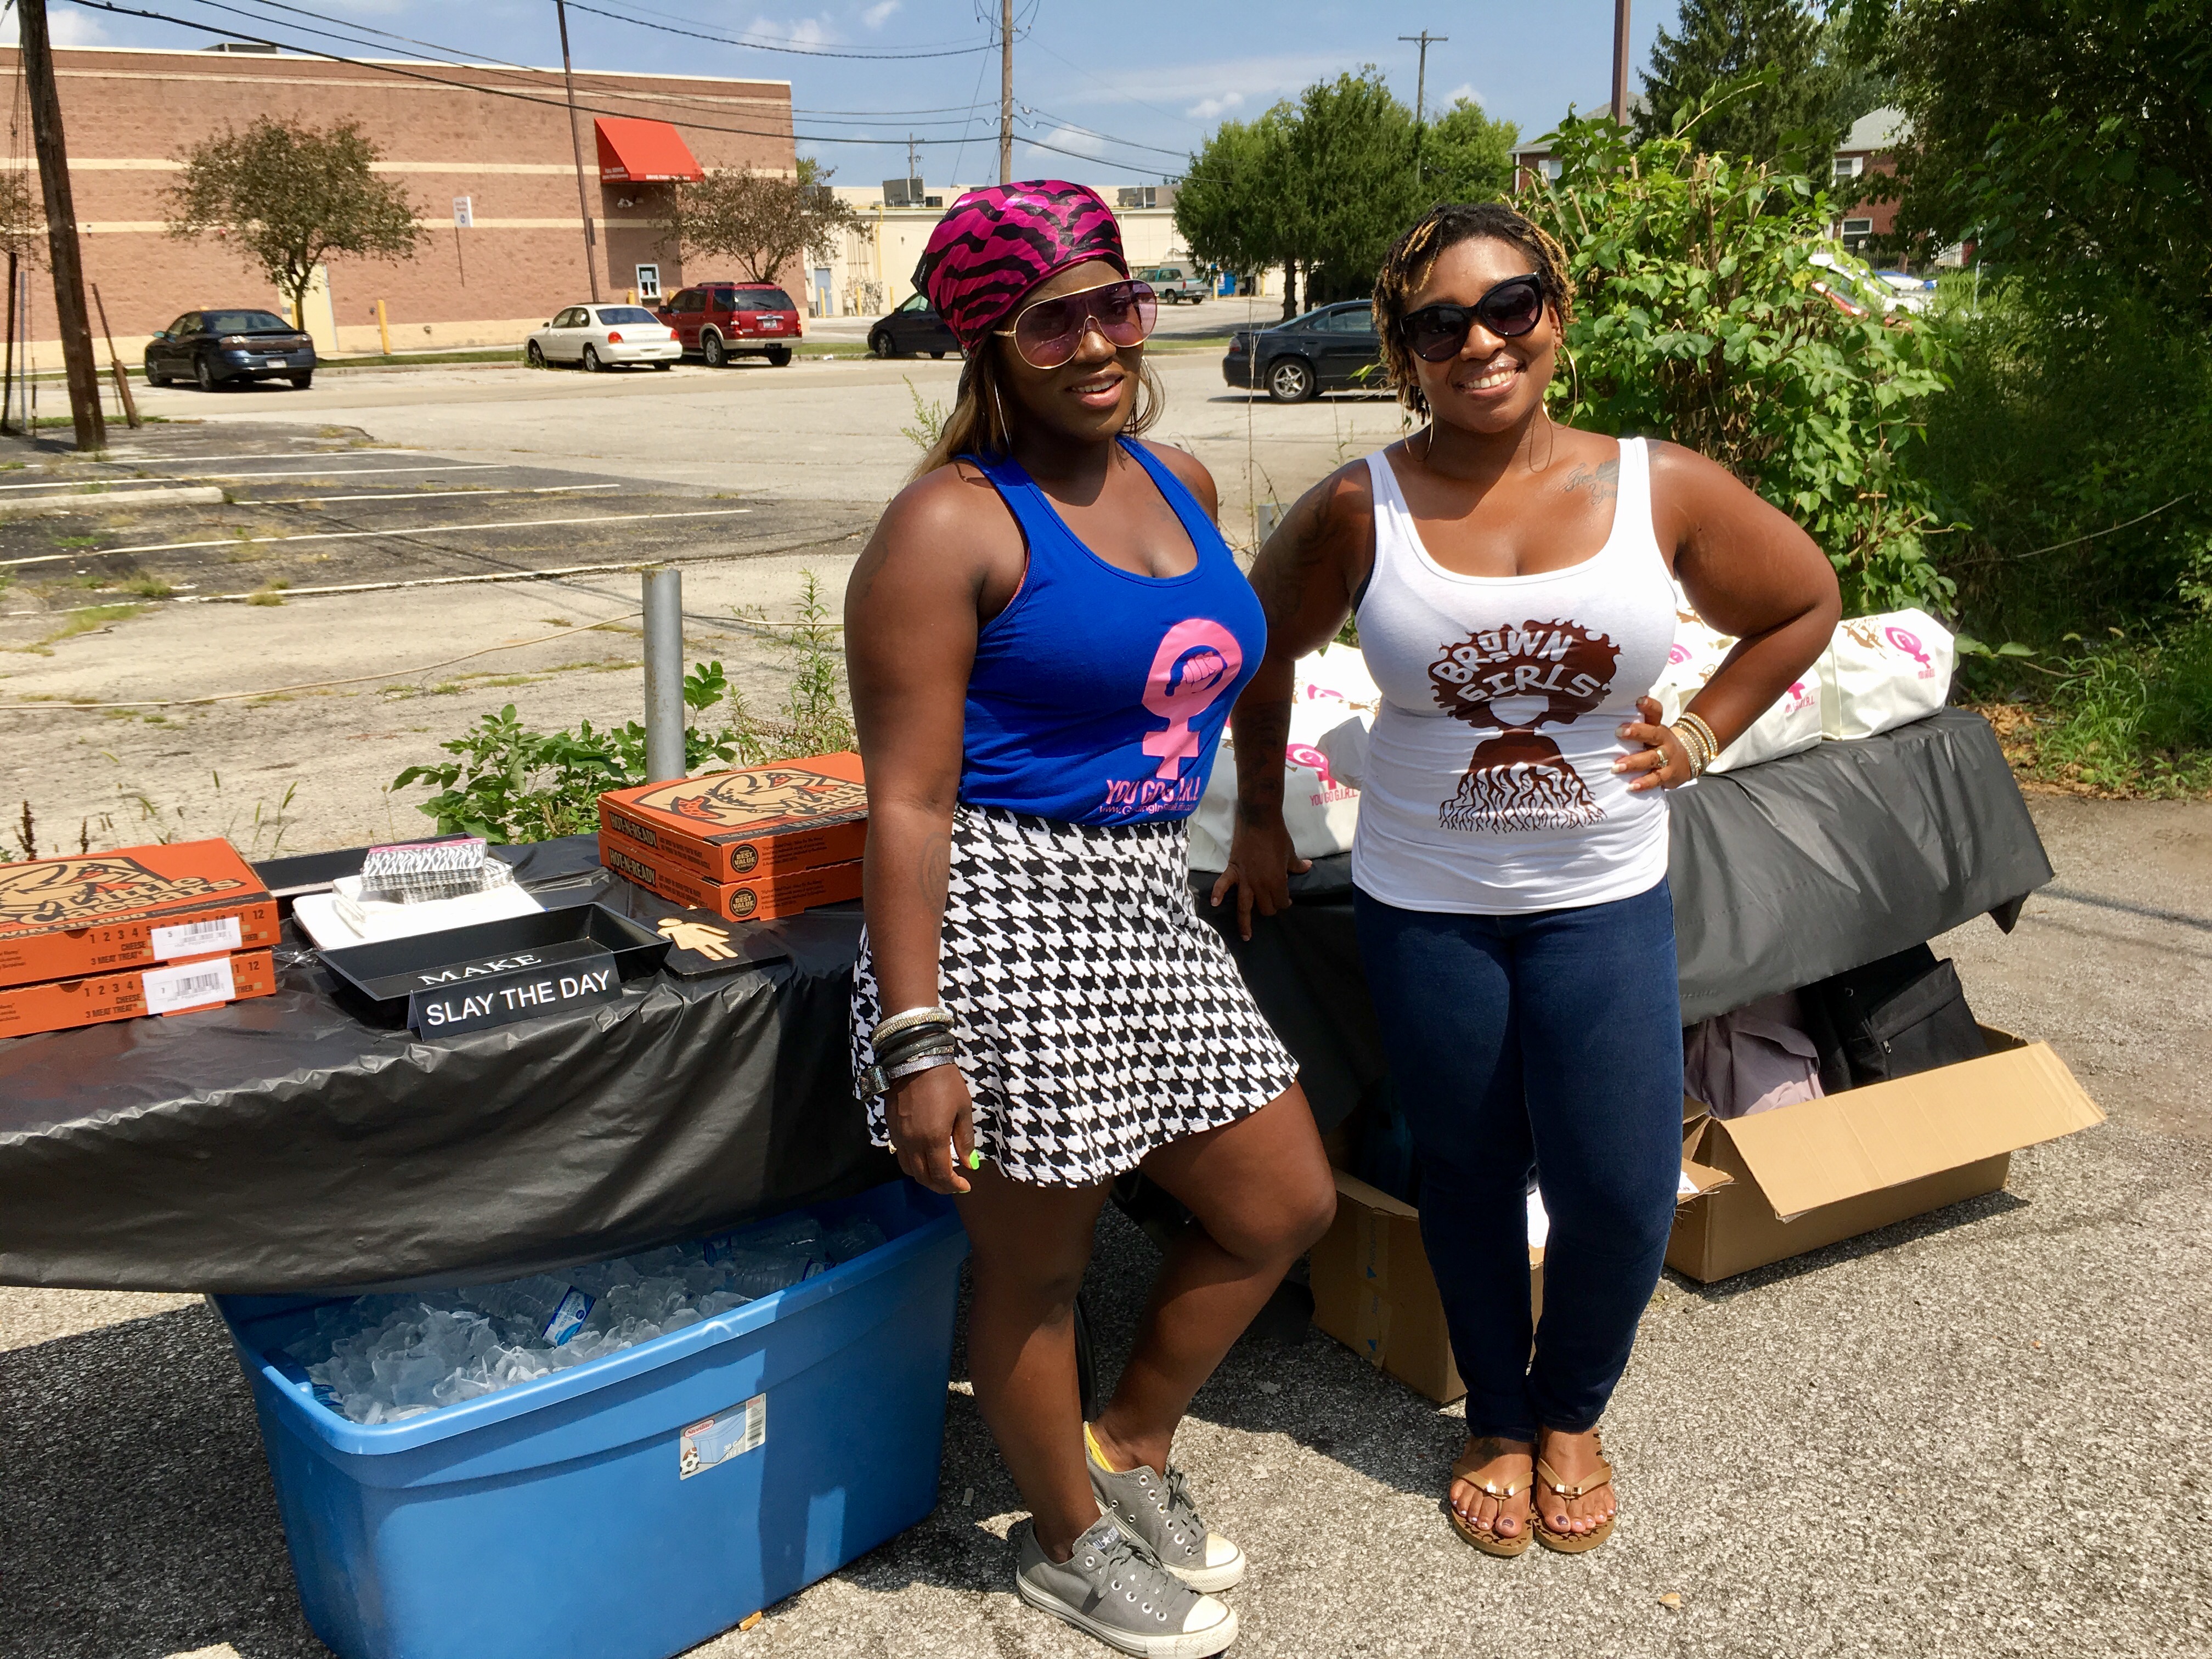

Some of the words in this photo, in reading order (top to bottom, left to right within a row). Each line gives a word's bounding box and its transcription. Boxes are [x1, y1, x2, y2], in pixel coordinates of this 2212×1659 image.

[1432, 630, 1573, 684] BROWN
[1457, 664, 1600, 702] GIRLS
[1105, 780, 1140, 805] YOU
[1141, 780, 1165, 804] GO
[1309, 793, 1323, 806] YOU
[1324, 791, 1334, 803] GO
[610, 812, 657, 848] HOT-N-READY
[787, 817, 828, 828] WIN
[609, 848, 656, 885] HOT-N-READY
[735, 857, 755, 865] VALUE
[20, 879, 241, 924] Caesars
[44, 878, 204, 912] Little
[733, 900, 754, 909] VALUE
[89, 934, 95, 944] 1
[104, 932, 110, 941] 2
[117, 930, 124, 939] 3
[132, 928, 138, 937] 4
[253, 909, 264, 919] 12
[121, 941, 146, 951] CHEESE
[98, 955, 116, 964] MEAT
[84, 988, 90, 997] 1
[98, 985, 105, 995] 2
[112, 983, 120, 992] 3
[127, 981, 133, 990] 4
[248, 961, 259, 971] 12
[417, 955, 542, 985] MAKE
[116, 994, 141, 1004] CHEESE
[426, 993, 494, 1026] SLAY
[500, 981, 556, 1010] THE
[559, 969, 610, 999] DAY
[93, 1008, 111, 1017] MEAT
[687, 1422, 713, 1436] Sterilite
[724, 1443, 731, 1452] 30
[732, 1438, 743, 1448] Gal
[726, 1449, 737, 1459] 114
